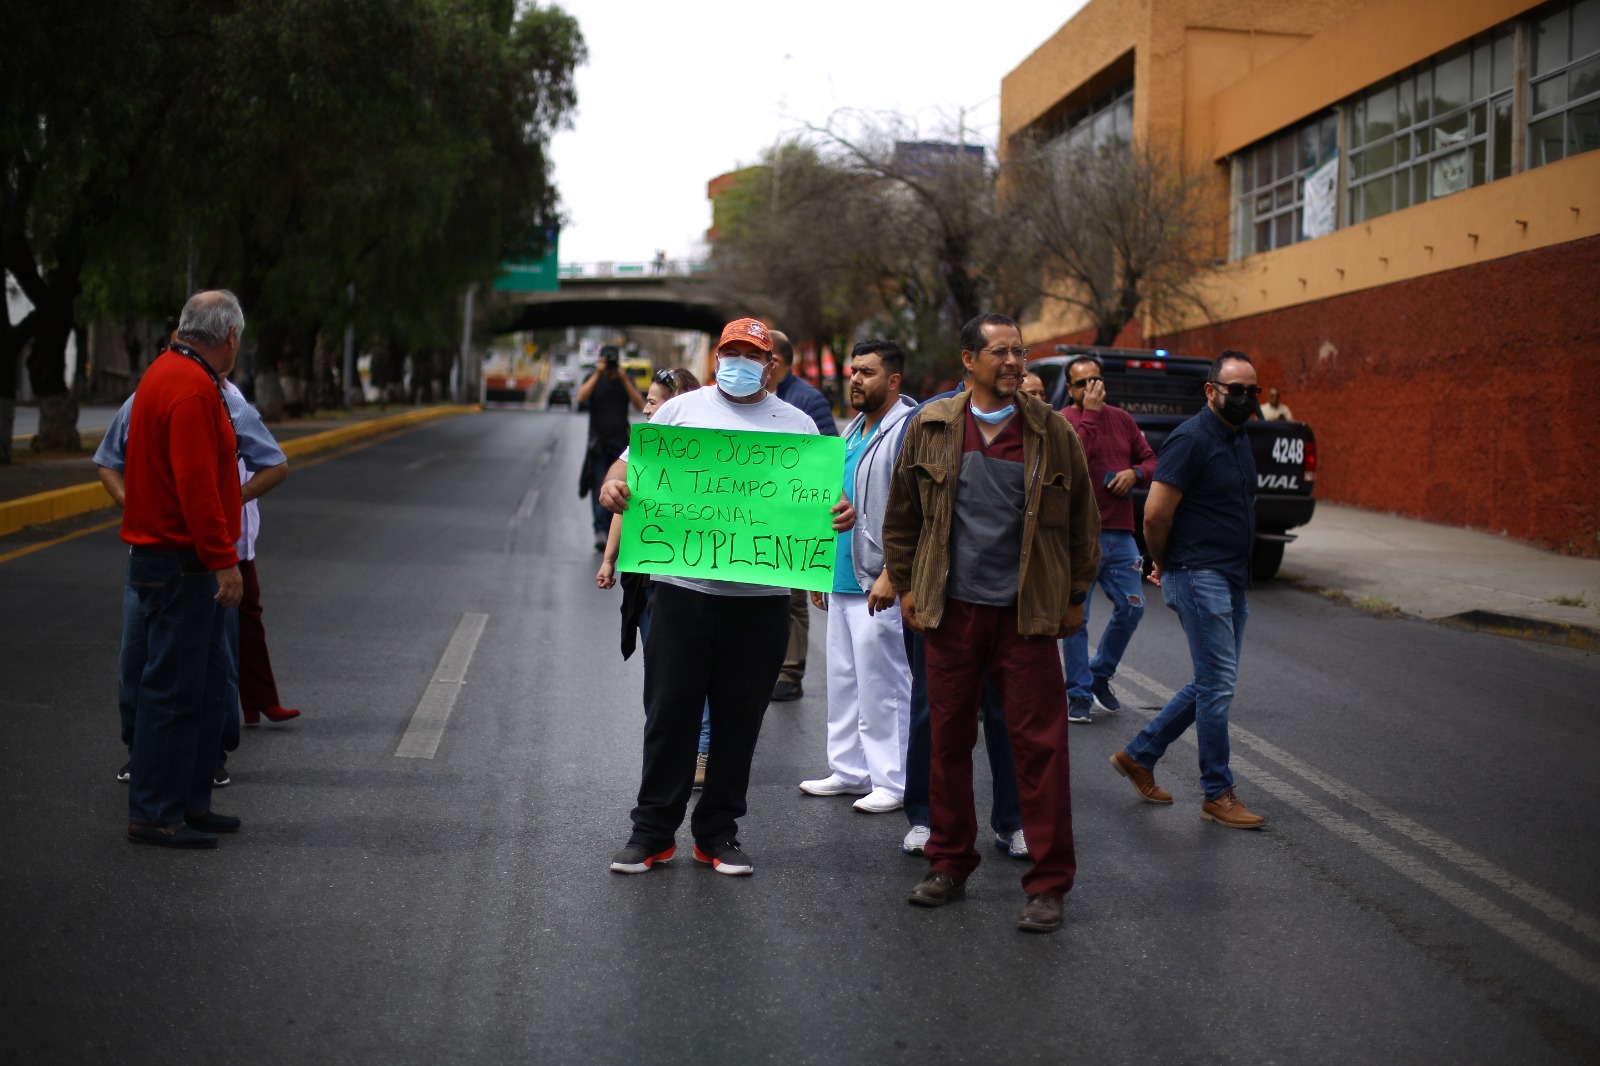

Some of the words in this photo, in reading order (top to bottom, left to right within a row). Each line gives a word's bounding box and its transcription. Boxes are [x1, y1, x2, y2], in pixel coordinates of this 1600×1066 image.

[637, 427, 701, 460] PAGO
[1272, 437, 1304, 464] 4248
[632, 464, 648, 492] Y
[656, 467, 673, 493] A
[685, 469, 777, 498] TIEMPO
[788, 478, 832, 504] PARA
[1257, 474, 1299, 489] VIAL
[638, 498, 768, 526] PERSONAL
[637, 524, 835, 572] SUPLENTE
